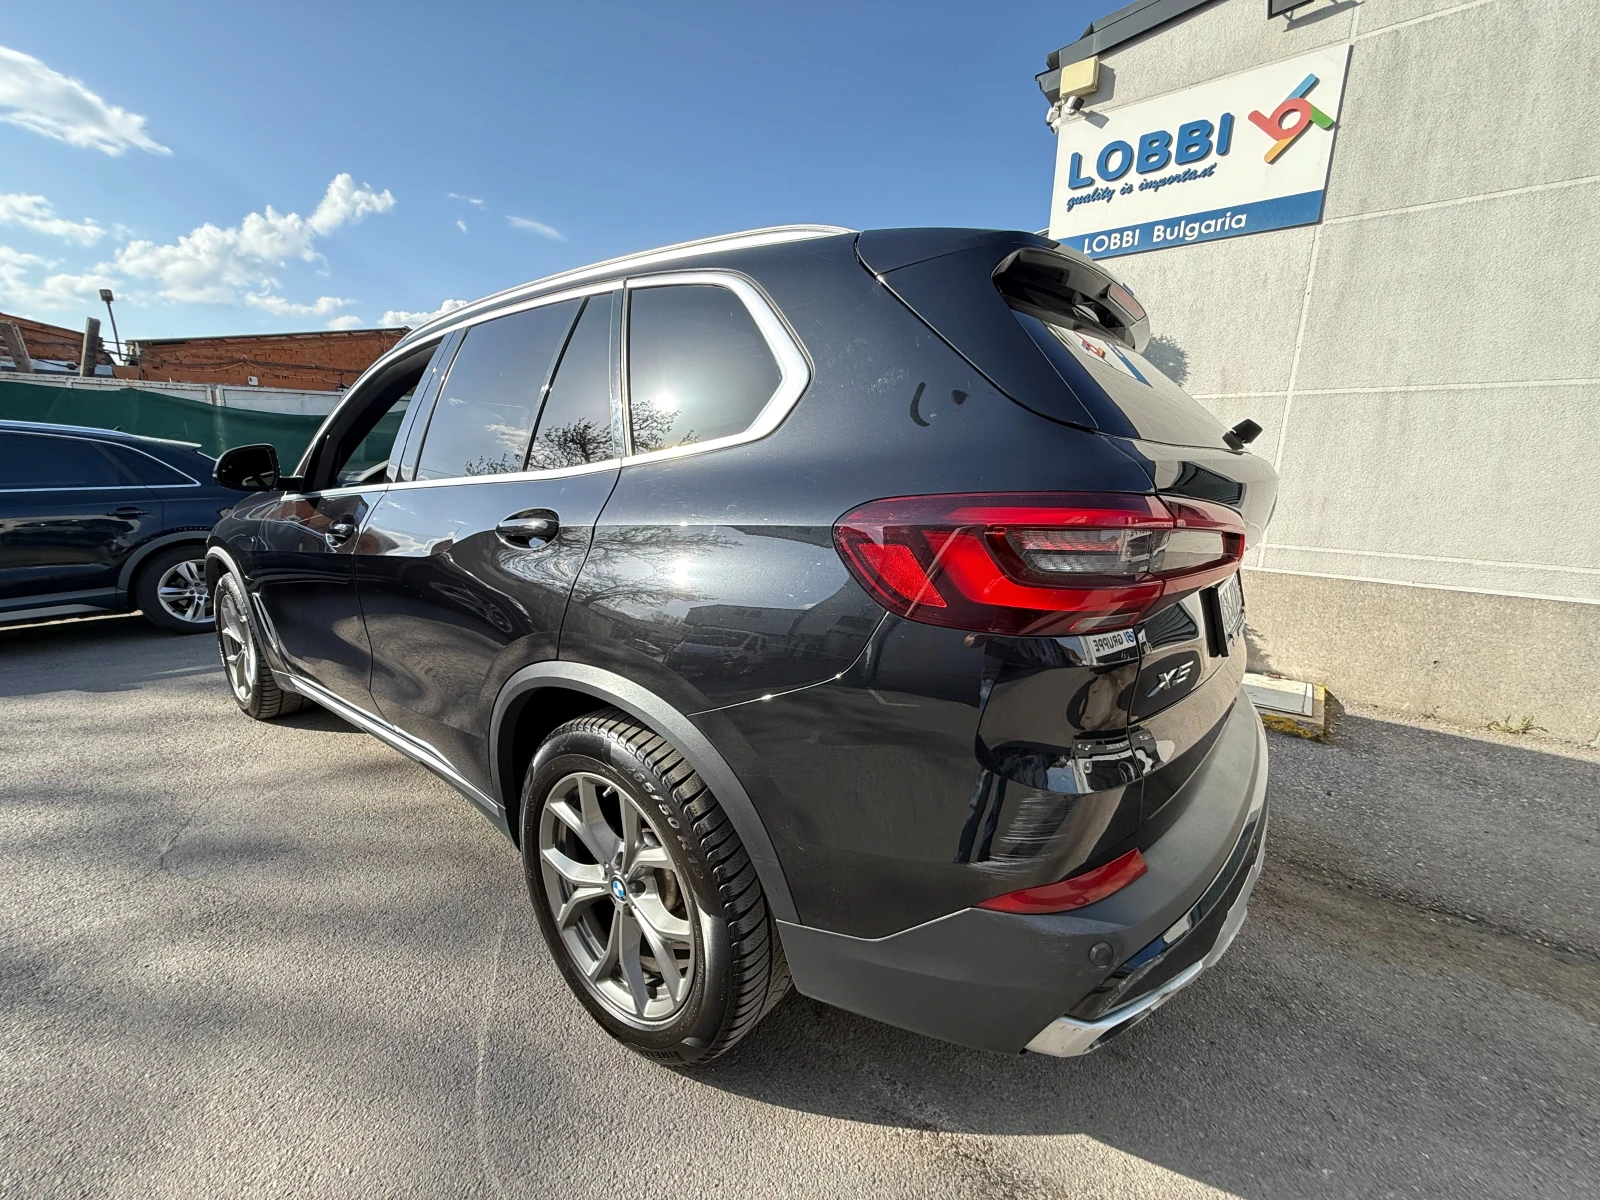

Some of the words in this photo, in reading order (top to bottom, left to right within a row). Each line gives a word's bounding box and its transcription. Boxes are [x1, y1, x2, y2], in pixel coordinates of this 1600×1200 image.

[1068, 112, 1233, 189] LOBBI
[1066, 187, 1116, 212] quality
[1120, 183, 1133, 195] is
[1083, 229, 1140, 254] LOBBI
[1152, 211, 1247, 242] Bulgaria
[1145, 660, 1194, 697] X5
